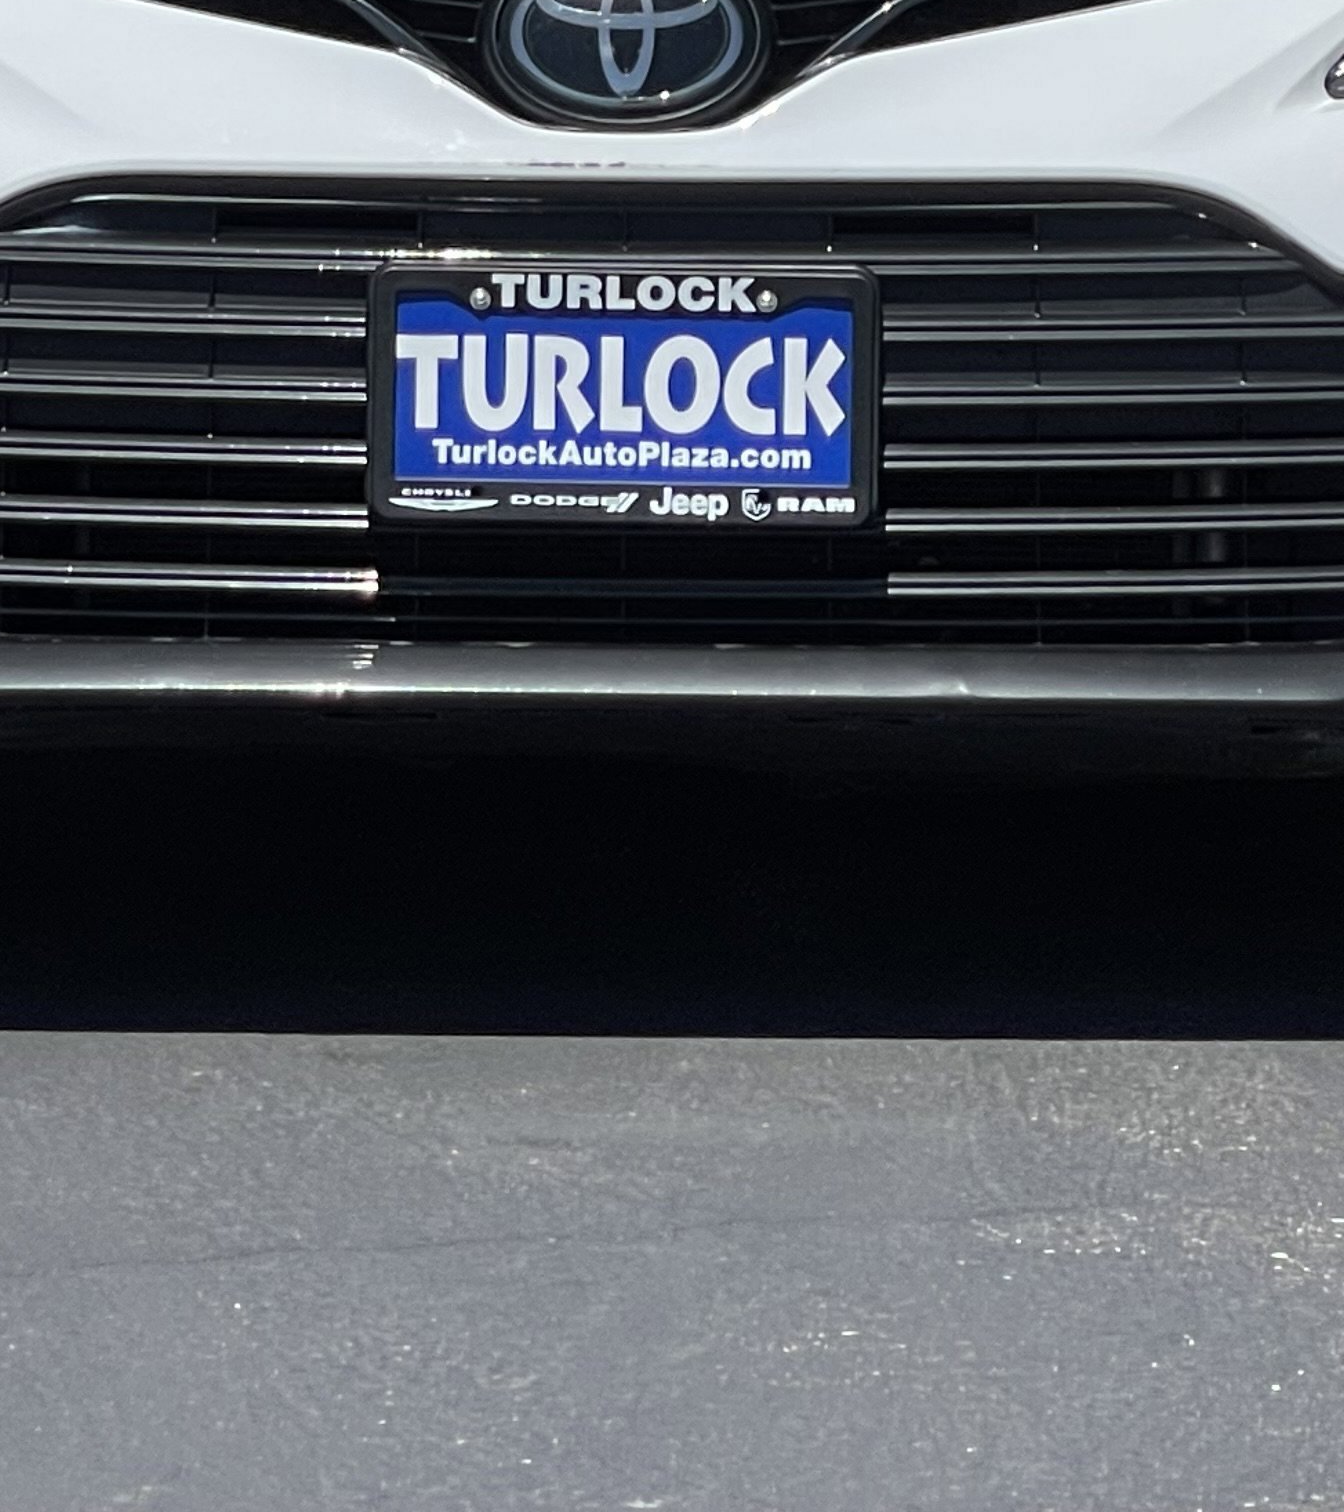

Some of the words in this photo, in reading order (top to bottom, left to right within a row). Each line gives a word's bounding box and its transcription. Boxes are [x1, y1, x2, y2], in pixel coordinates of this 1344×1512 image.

[491, 274, 756, 313] TURLOCK
[396, 333, 846, 437] TURLOCK
[432, 438, 812, 470] TurlockAutoPlaza.com
[649, 486, 729, 522] Jeep
[777, 497, 855, 513] RAM
